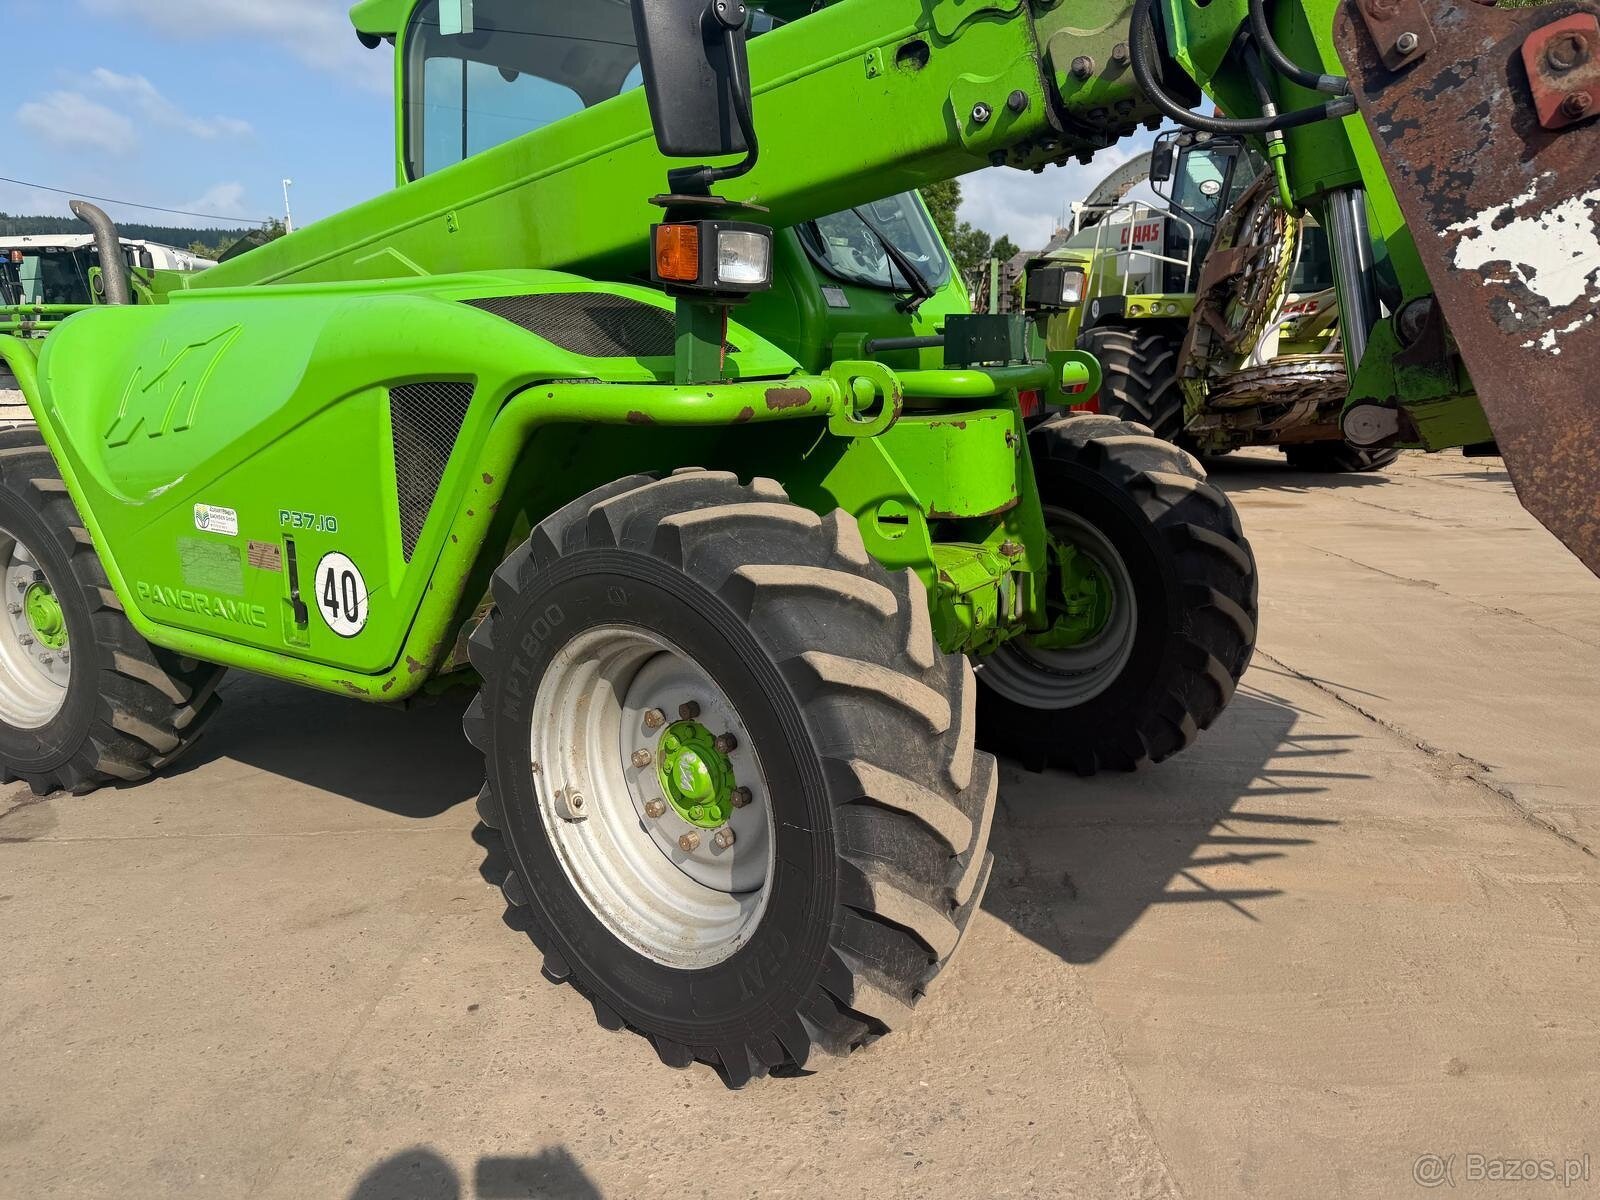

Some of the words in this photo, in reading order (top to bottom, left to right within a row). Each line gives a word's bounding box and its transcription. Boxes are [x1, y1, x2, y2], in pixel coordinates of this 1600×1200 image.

[137, 580, 268, 629] PANORAMIC
[322, 566, 360, 624] 40
[520, 603, 566, 657] 800
